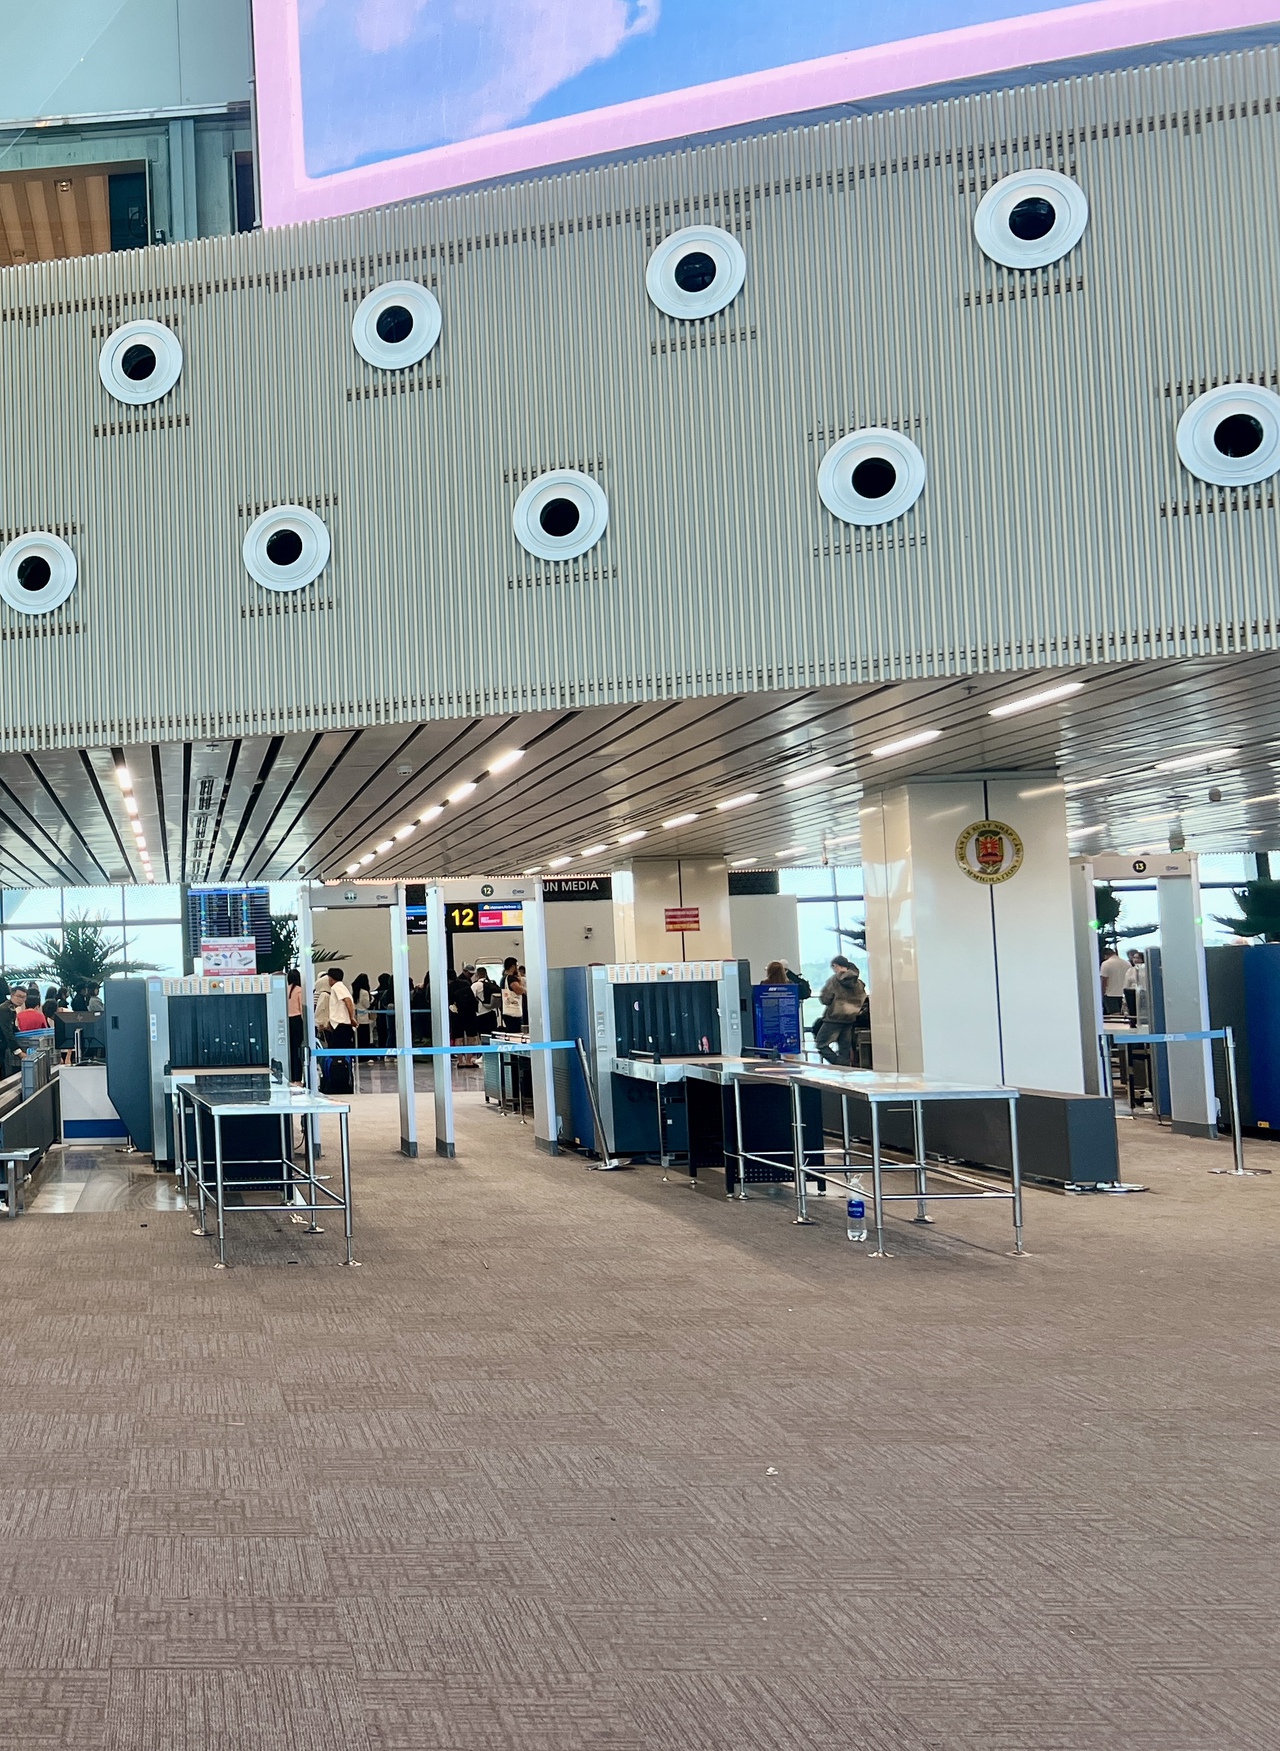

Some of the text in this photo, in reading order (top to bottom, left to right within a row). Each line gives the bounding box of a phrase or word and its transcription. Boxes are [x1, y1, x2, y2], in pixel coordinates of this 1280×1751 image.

[542, 880, 599, 892] UN MEDIA
[451, 908, 474, 926] 12
